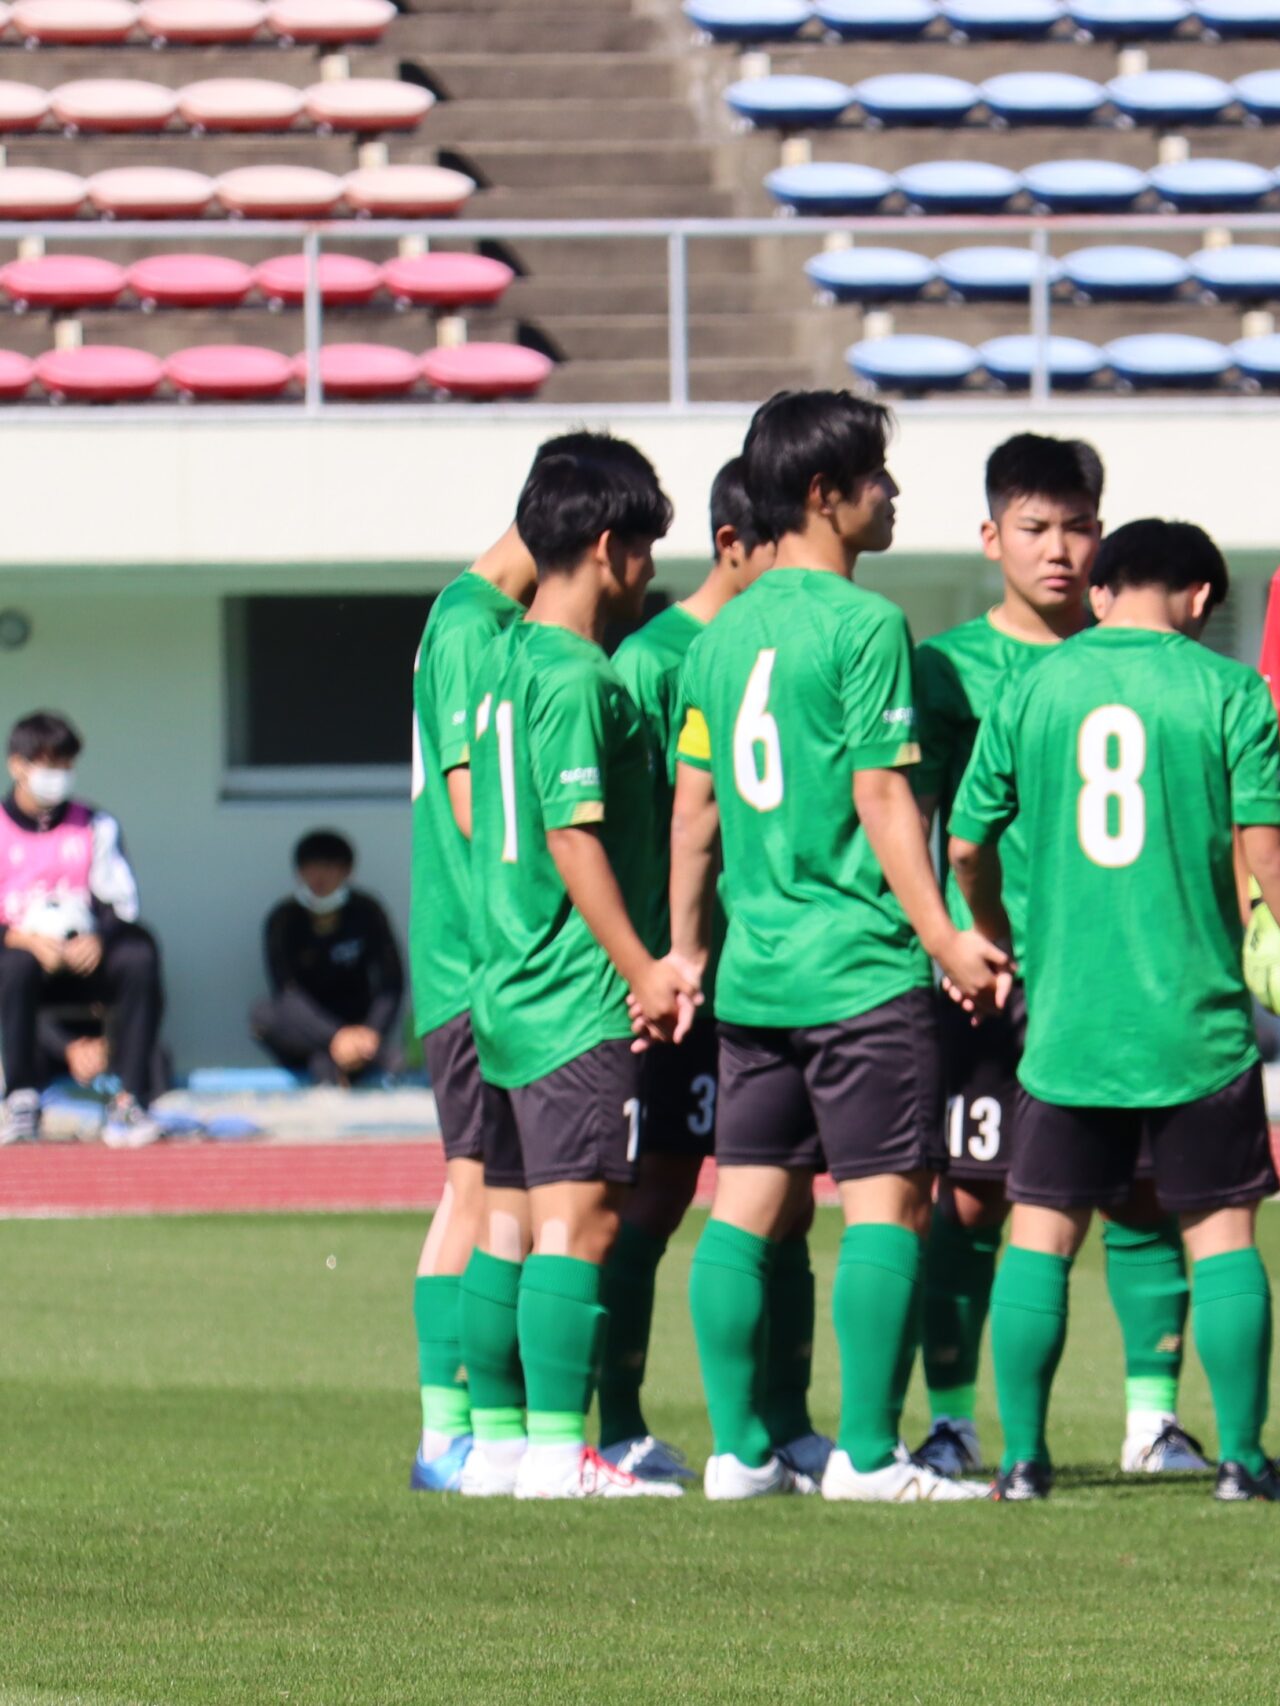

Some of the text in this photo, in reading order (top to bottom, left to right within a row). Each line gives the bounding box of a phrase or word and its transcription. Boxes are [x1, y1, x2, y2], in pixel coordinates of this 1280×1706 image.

[733, 648, 784, 813] 6
[1076, 703, 1146, 869] 8
[687, 1073, 716, 1135] 3
[945, 1094, 1002, 1162] 13
